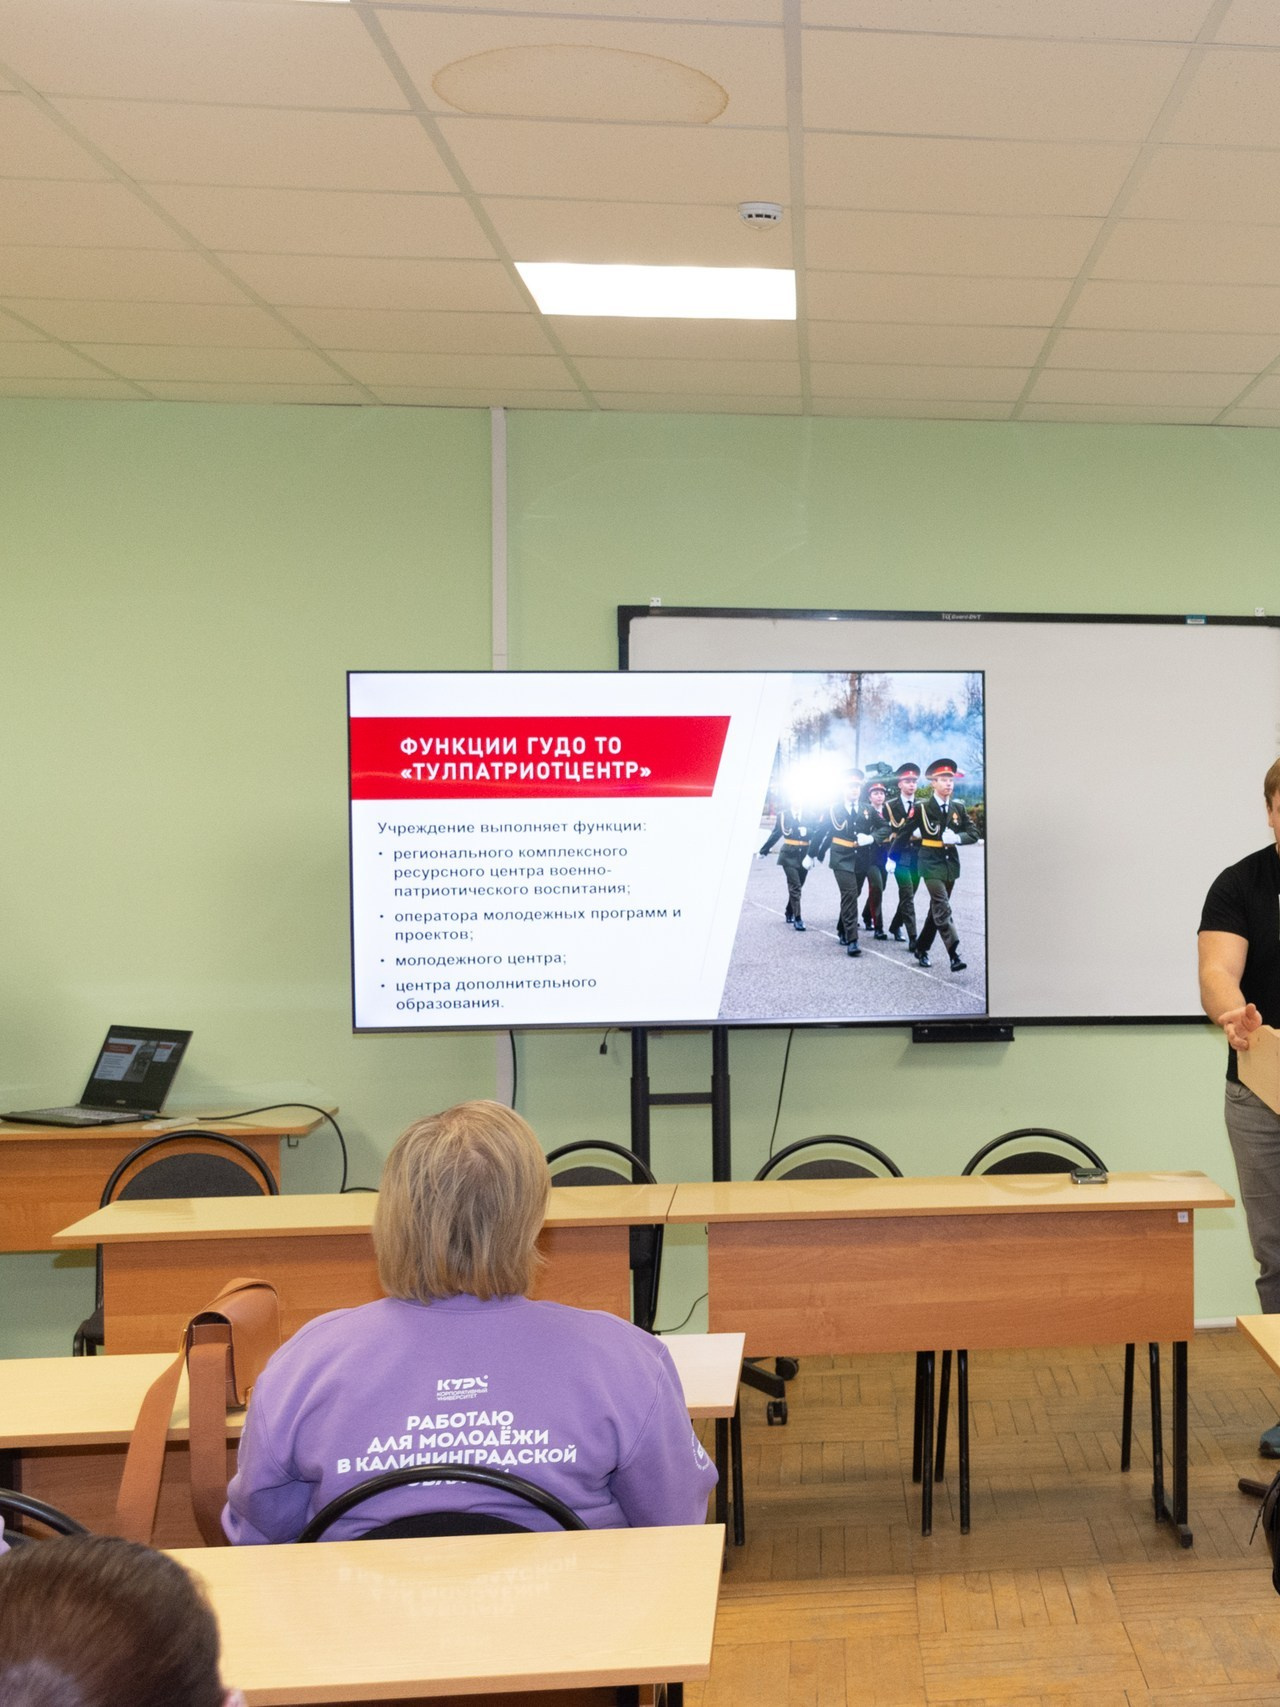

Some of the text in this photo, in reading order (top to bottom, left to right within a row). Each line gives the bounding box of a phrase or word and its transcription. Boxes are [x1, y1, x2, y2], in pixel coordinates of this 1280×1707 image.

[400, 736, 622, 758] ФУНКЦИИ ГУДО ТО
[401, 761, 652, 782] «ТУЛПАТРИОТЦЕНТР»
[378, 820, 647, 835] Учреждение выполняет функции:
[394, 847, 628, 862] регионального комплексного
[394, 866, 612, 880] ресурсного центра военно-
[394, 884, 631, 899] патриотического воспитания;
[394, 908, 682, 924] оператора молодежных программ и
[395, 930, 474, 943] проектов;
[396, 953, 567, 967] молодежного центра;
[396, 978, 597, 993] центра дополнительного
[396, 998, 504, 1012] образования.
[407, 1411, 514, 1431] РАБОТАЮ
[367, 1427, 549, 1454] ДЛЯ МОЛОДЁЖИ
[337, 1444, 577, 1474] В КАЛИНИНГРАДСКОЙ
